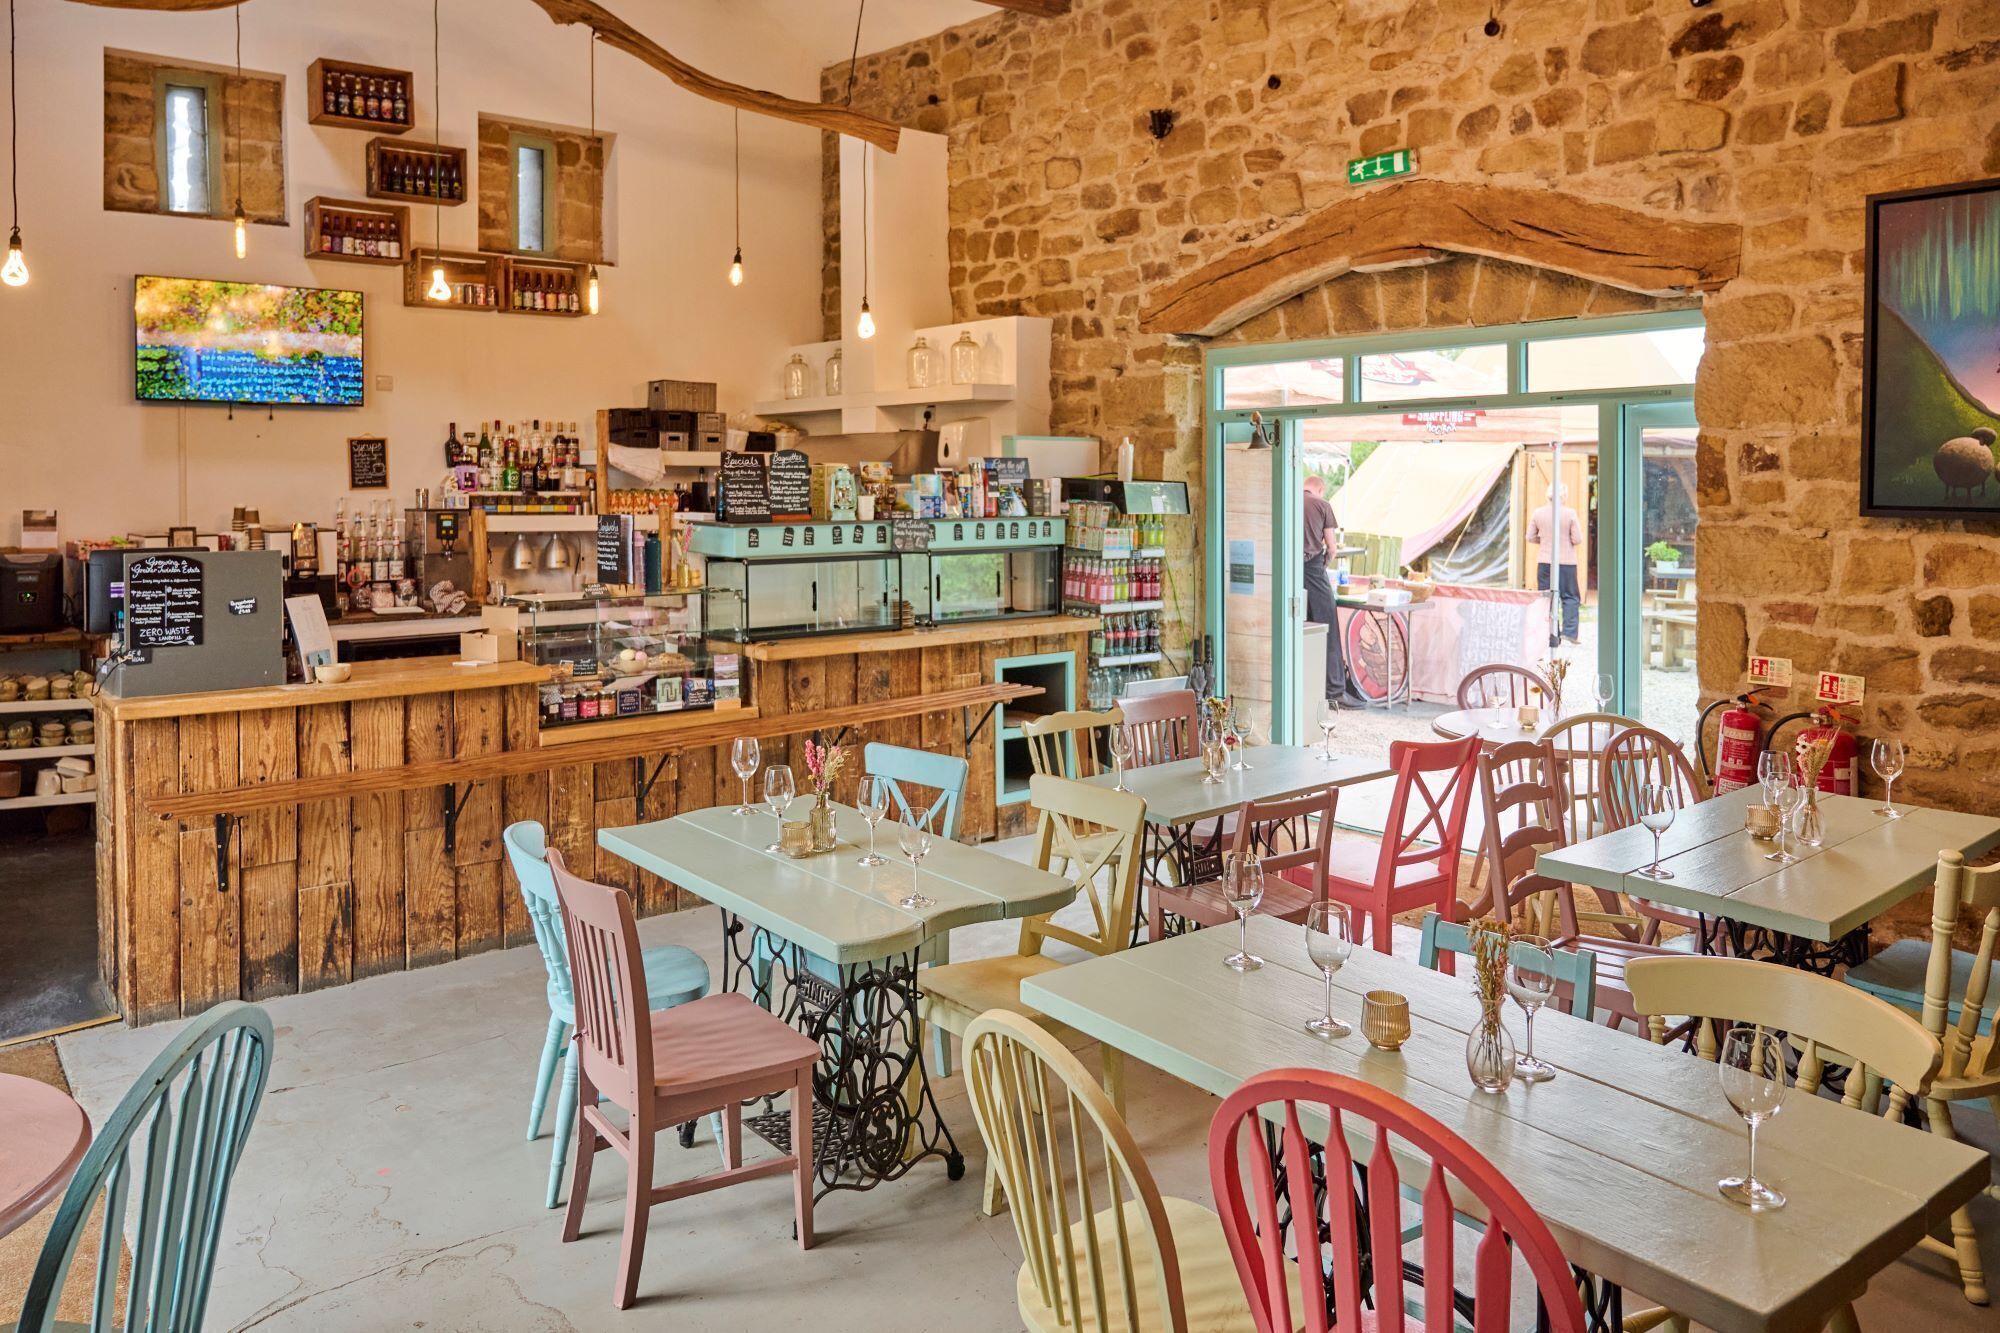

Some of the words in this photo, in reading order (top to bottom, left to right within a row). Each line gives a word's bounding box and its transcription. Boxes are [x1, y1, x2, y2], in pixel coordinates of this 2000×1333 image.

[352, 440, 382, 457] Syrups
[724, 452, 758, 465] Specials
[772, 452, 802, 466] Baguettes
[145, 557, 180, 569] Growing
[131, 564, 158, 578] Greater
[182, 565, 200, 573] Estate
[140, 628, 163, 637] ZERO
[165, 626, 190, 635] WASTE
